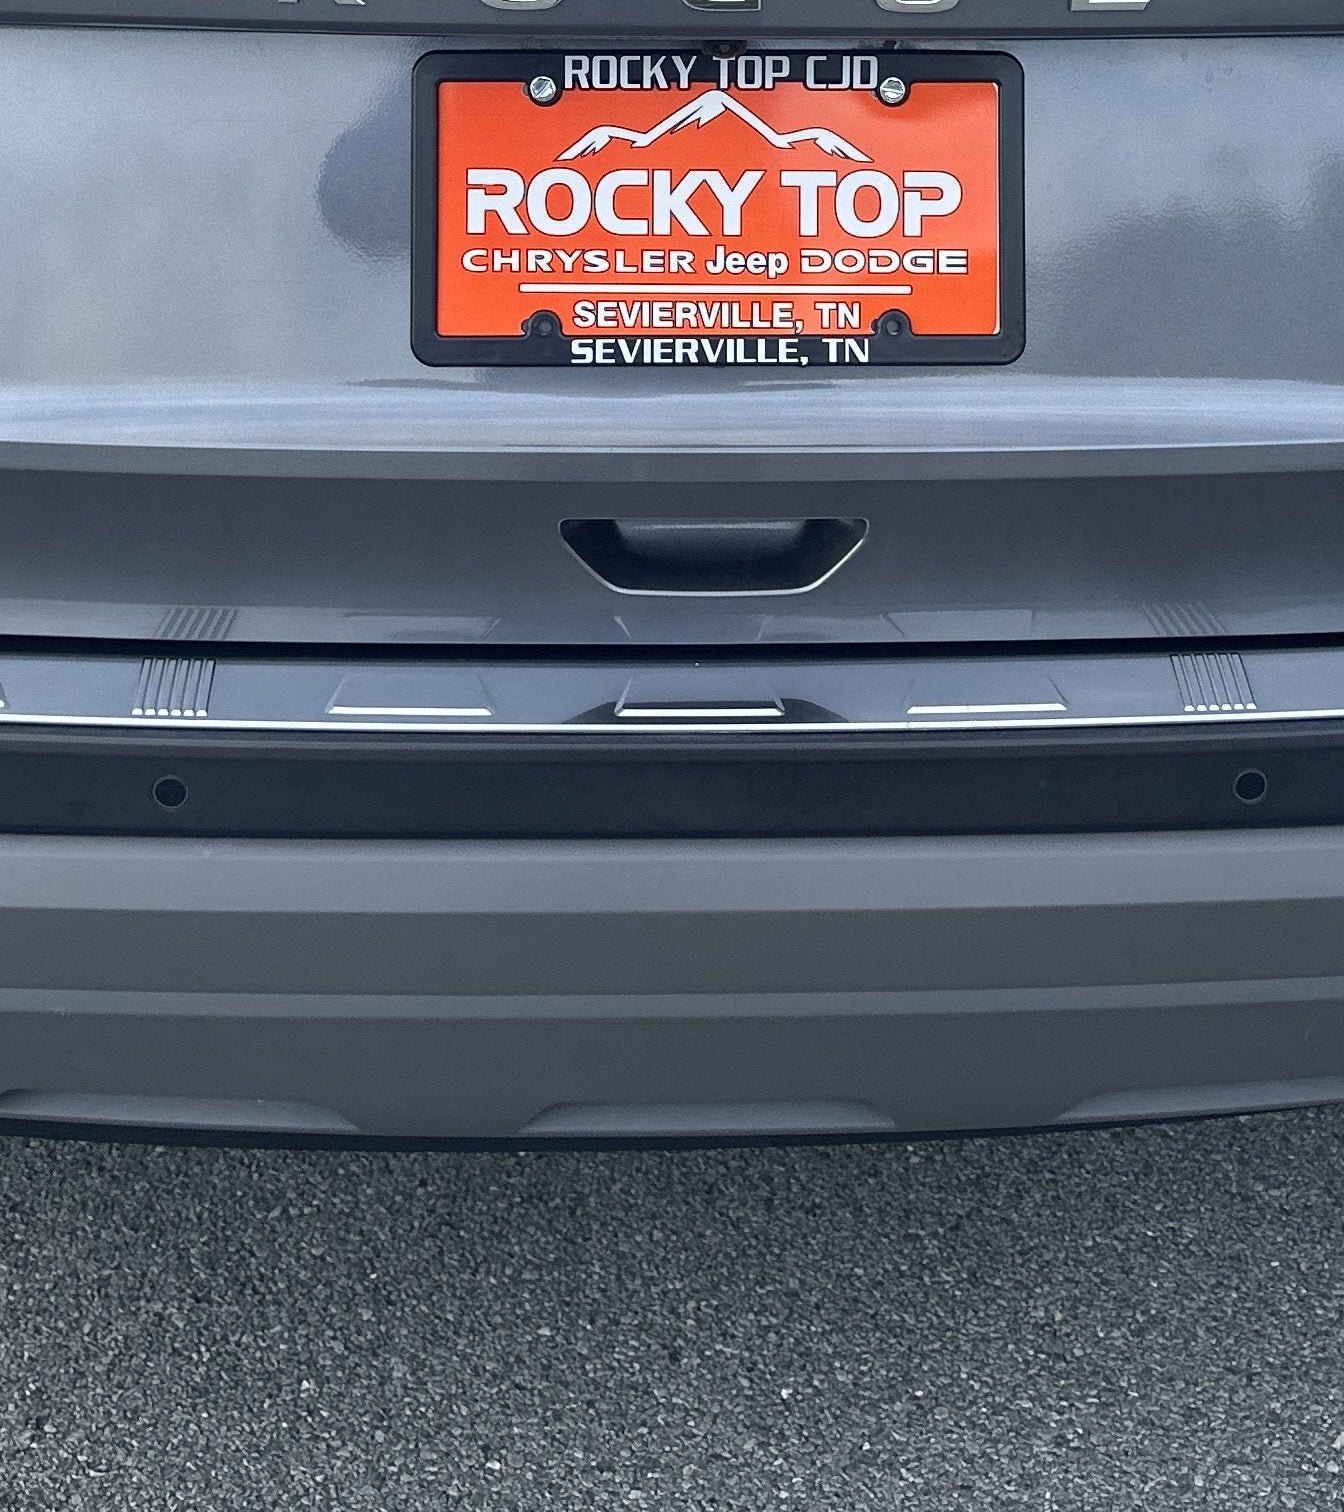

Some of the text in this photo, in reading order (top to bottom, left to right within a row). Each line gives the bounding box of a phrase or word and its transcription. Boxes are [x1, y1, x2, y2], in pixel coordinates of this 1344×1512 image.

[563, 54, 879, 90] ROCKY TOP CJD
[465, 167, 964, 239] ROCKY TOP
[461, 245, 970, 279] CHRYSLER Jeep DODGE
[571, 299, 861, 335] SEVIERVILLE, TN
[570, 337, 870, 366] SEVIERVILLE, TN
